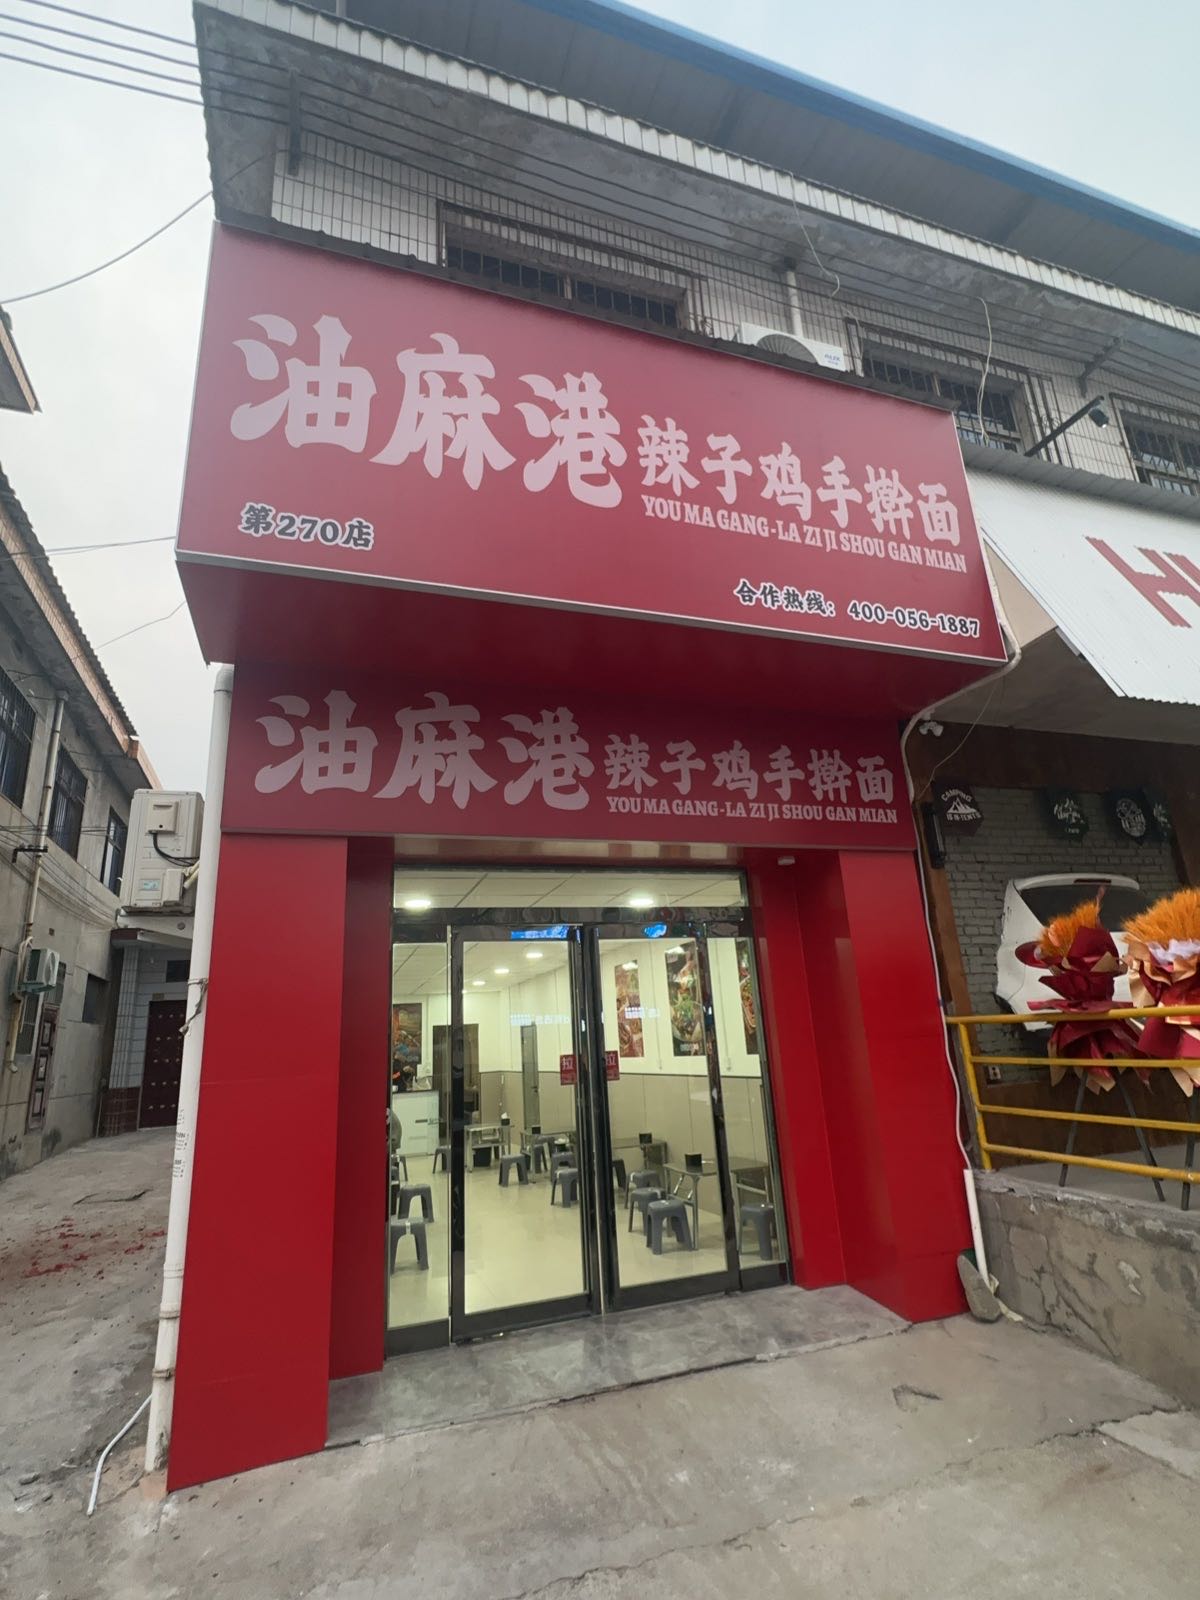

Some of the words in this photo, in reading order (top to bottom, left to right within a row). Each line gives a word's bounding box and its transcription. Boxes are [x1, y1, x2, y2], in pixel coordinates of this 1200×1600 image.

[230, 314, 627, 508] 油麻港
[637, 414, 961, 546] 辣子鸡手擀面
[239, 503, 374, 550] 第270店
[641, 495, 681, 521] YOU
[683, 503, 716, 528] MA
[803, 525, 823, 547] ZI
[823, 529, 838, 552] JI
[840, 532, 885, 558] SHOU
[888, 541, 923, 565] GAN
[925, 548, 967, 573] MIAN
[848, 600, 980, 638] 400-056-1887
[255, 689, 595, 810] 油麻港
[604, 734, 894, 803] 辣子鸡手擀面
[606, 796, 641, 813] YOU
[643, 798, 671, 815] MA
[749, 802, 766, 818] ZI
[767, 803, 780, 821] JI
[782, 803, 823, 820] SHOU
[825, 806, 857, 822] GAN
[858, 807, 898, 823] MIAN
